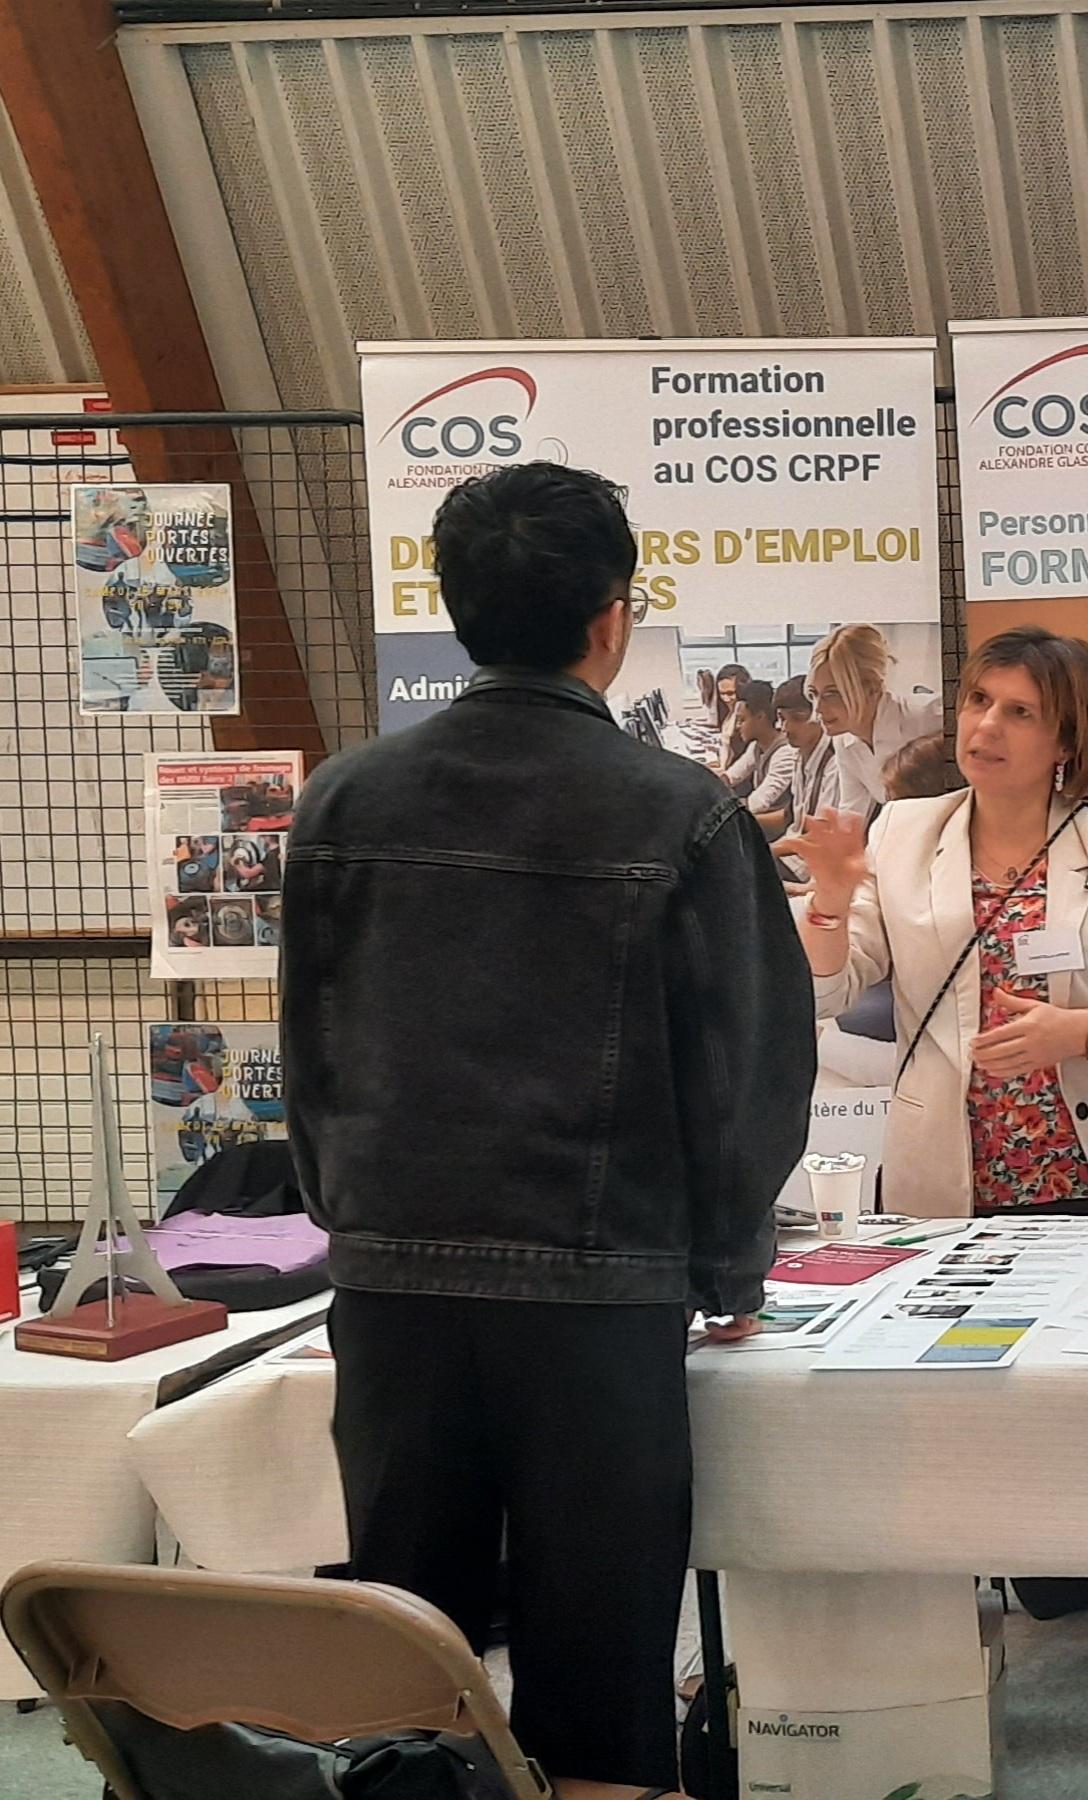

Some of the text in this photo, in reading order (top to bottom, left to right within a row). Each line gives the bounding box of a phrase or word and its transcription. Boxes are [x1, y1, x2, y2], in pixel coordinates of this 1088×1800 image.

[651, 365, 825, 394] Formation
[653, 408, 917, 446] professionnelle
[402, 415, 522, 458] COS
[999, 444, 1073, 458] FONDATION
[407, 464, 482, 477] FONDATION
[654, 454, 881, 483] au COS CRPF
[979, 457, 1054, 470] ALEXANDRE
[714, 527, 920, 565] D'EMPLOI
[222, 1083, 282, 1099] OUVERT
[853, 1101, 874, 1116] du
[748, 1720, 840, 1738] NAVIGATOR
